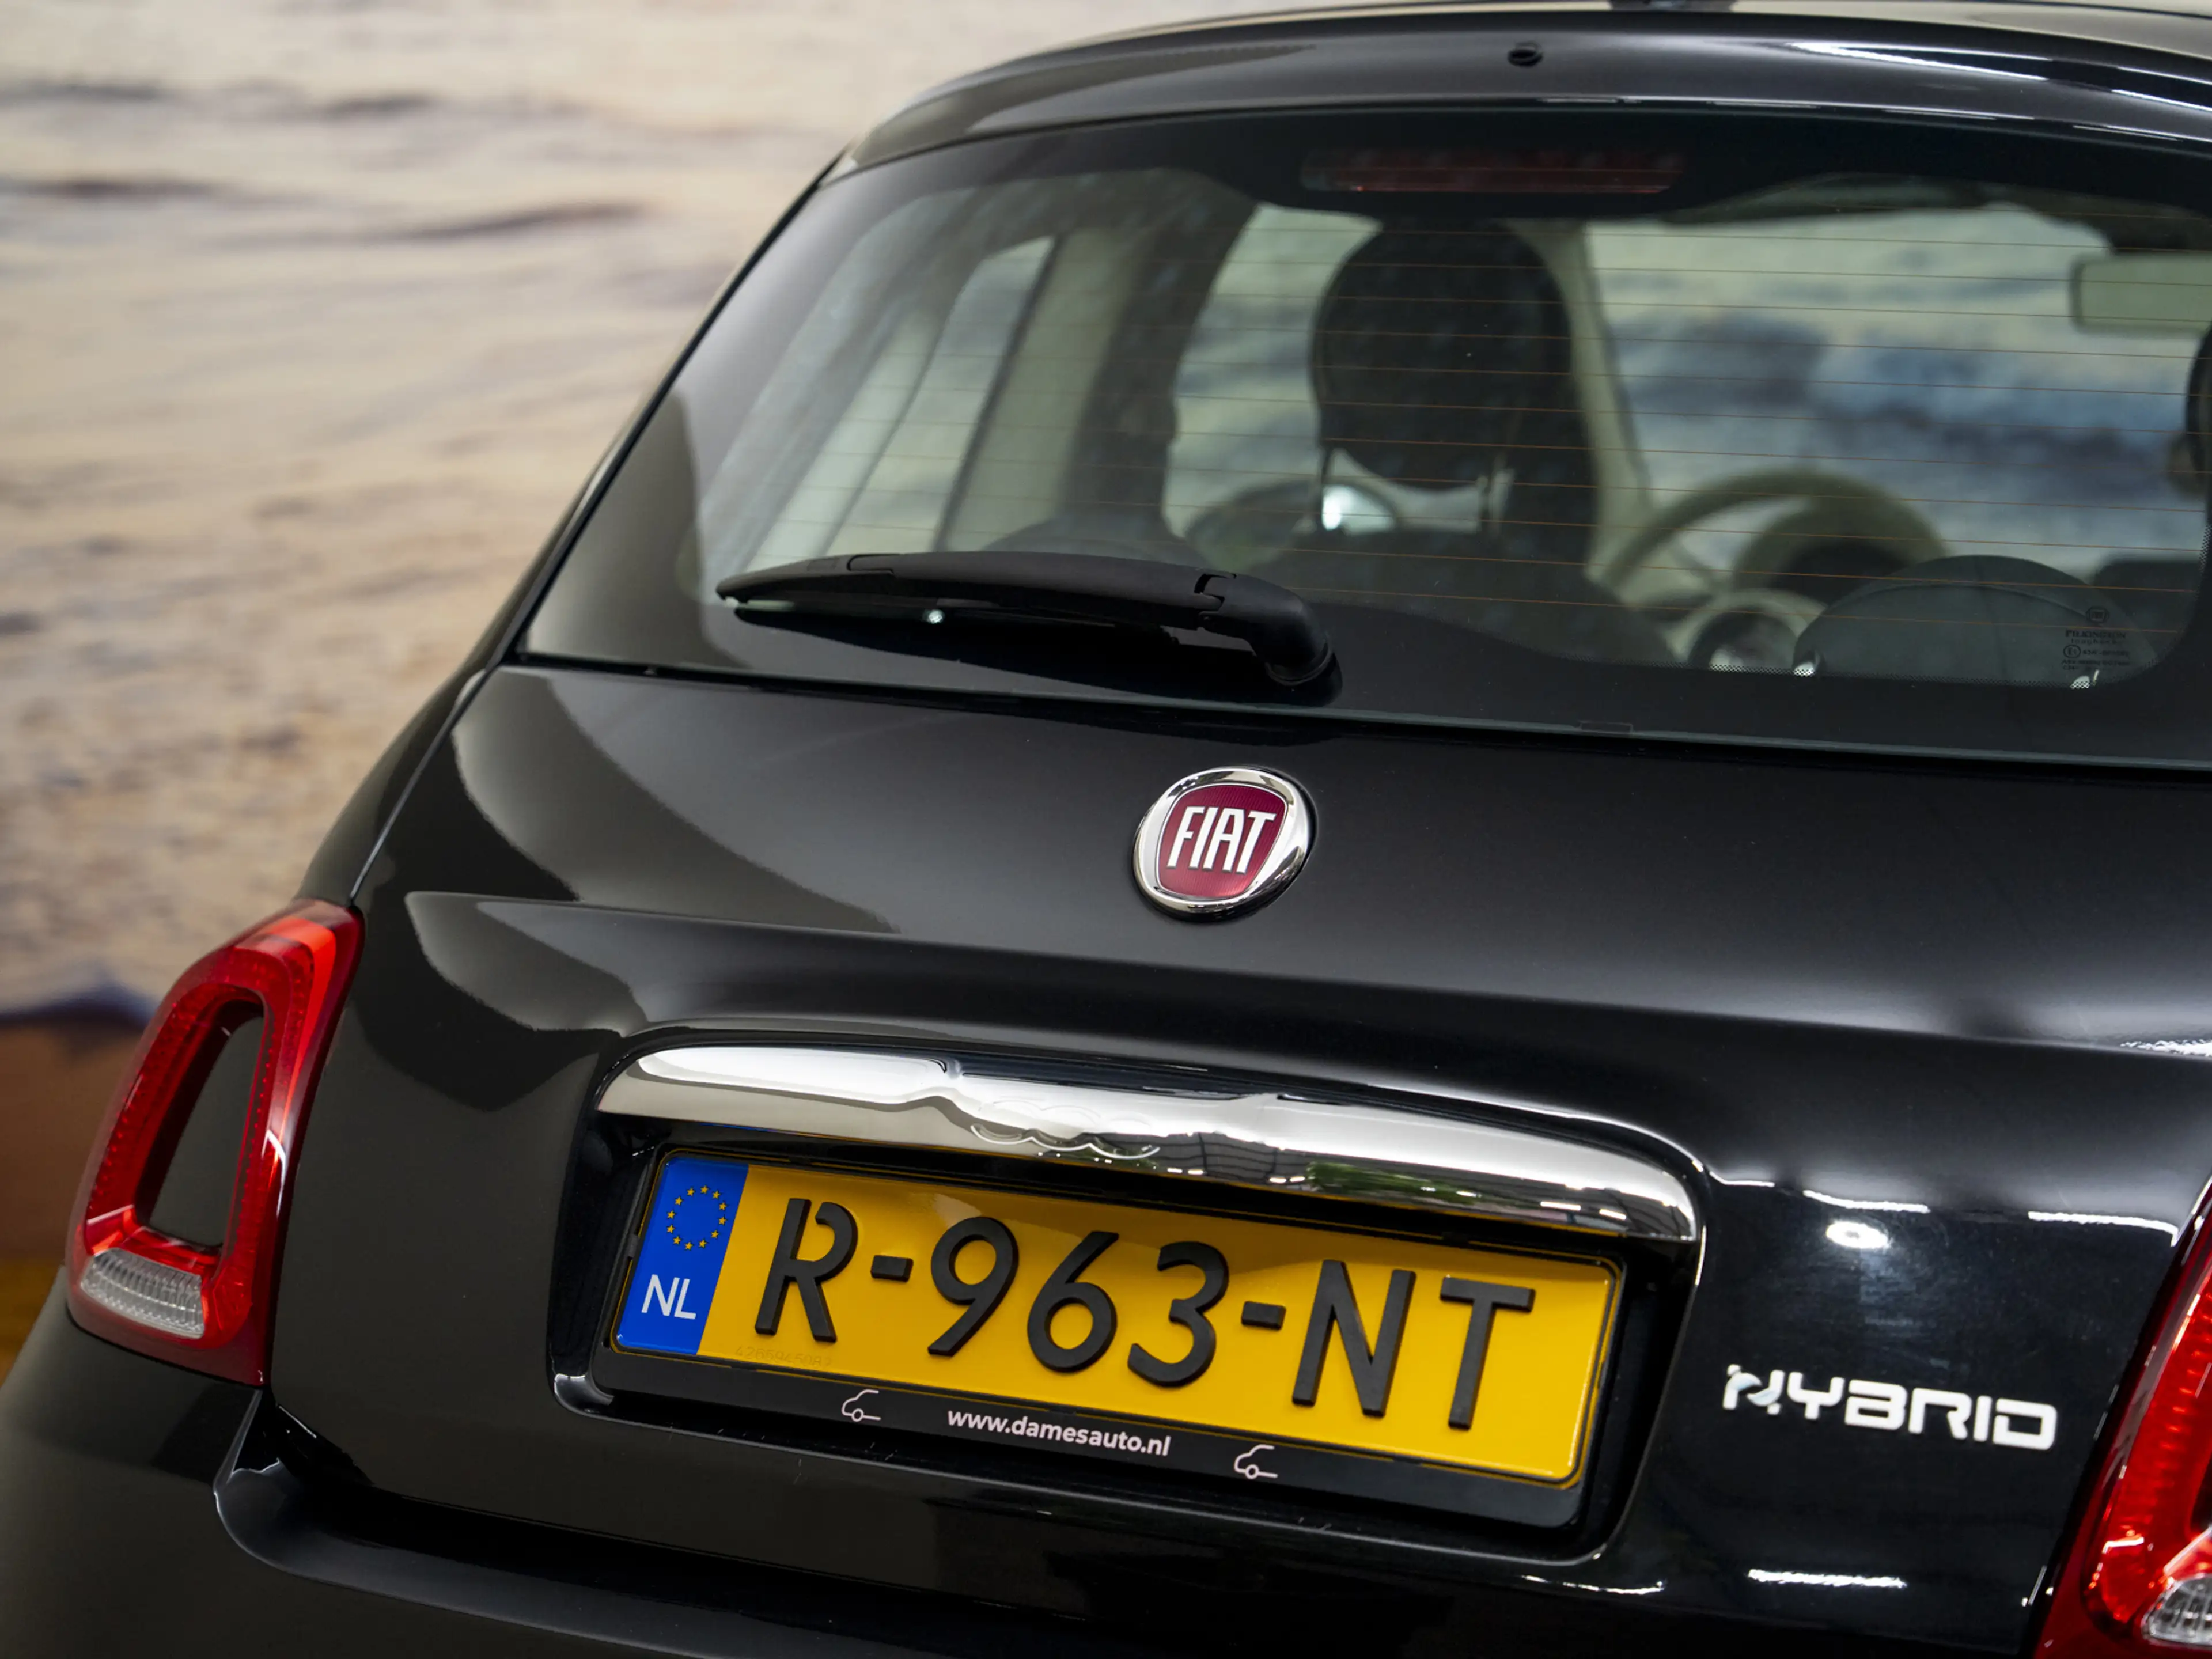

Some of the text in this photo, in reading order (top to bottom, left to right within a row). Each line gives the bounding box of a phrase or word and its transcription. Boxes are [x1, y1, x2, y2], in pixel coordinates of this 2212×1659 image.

[1166, 806, 1277, 874] FIAT
[642, 1274, 696, 1319] NL
[755, 1198, 1535, 1430] R-963-NT
[948, 1410, 1171, 1456] www.damesauto.nl
[1723, 1364, 2057, 1450] HYBRID
